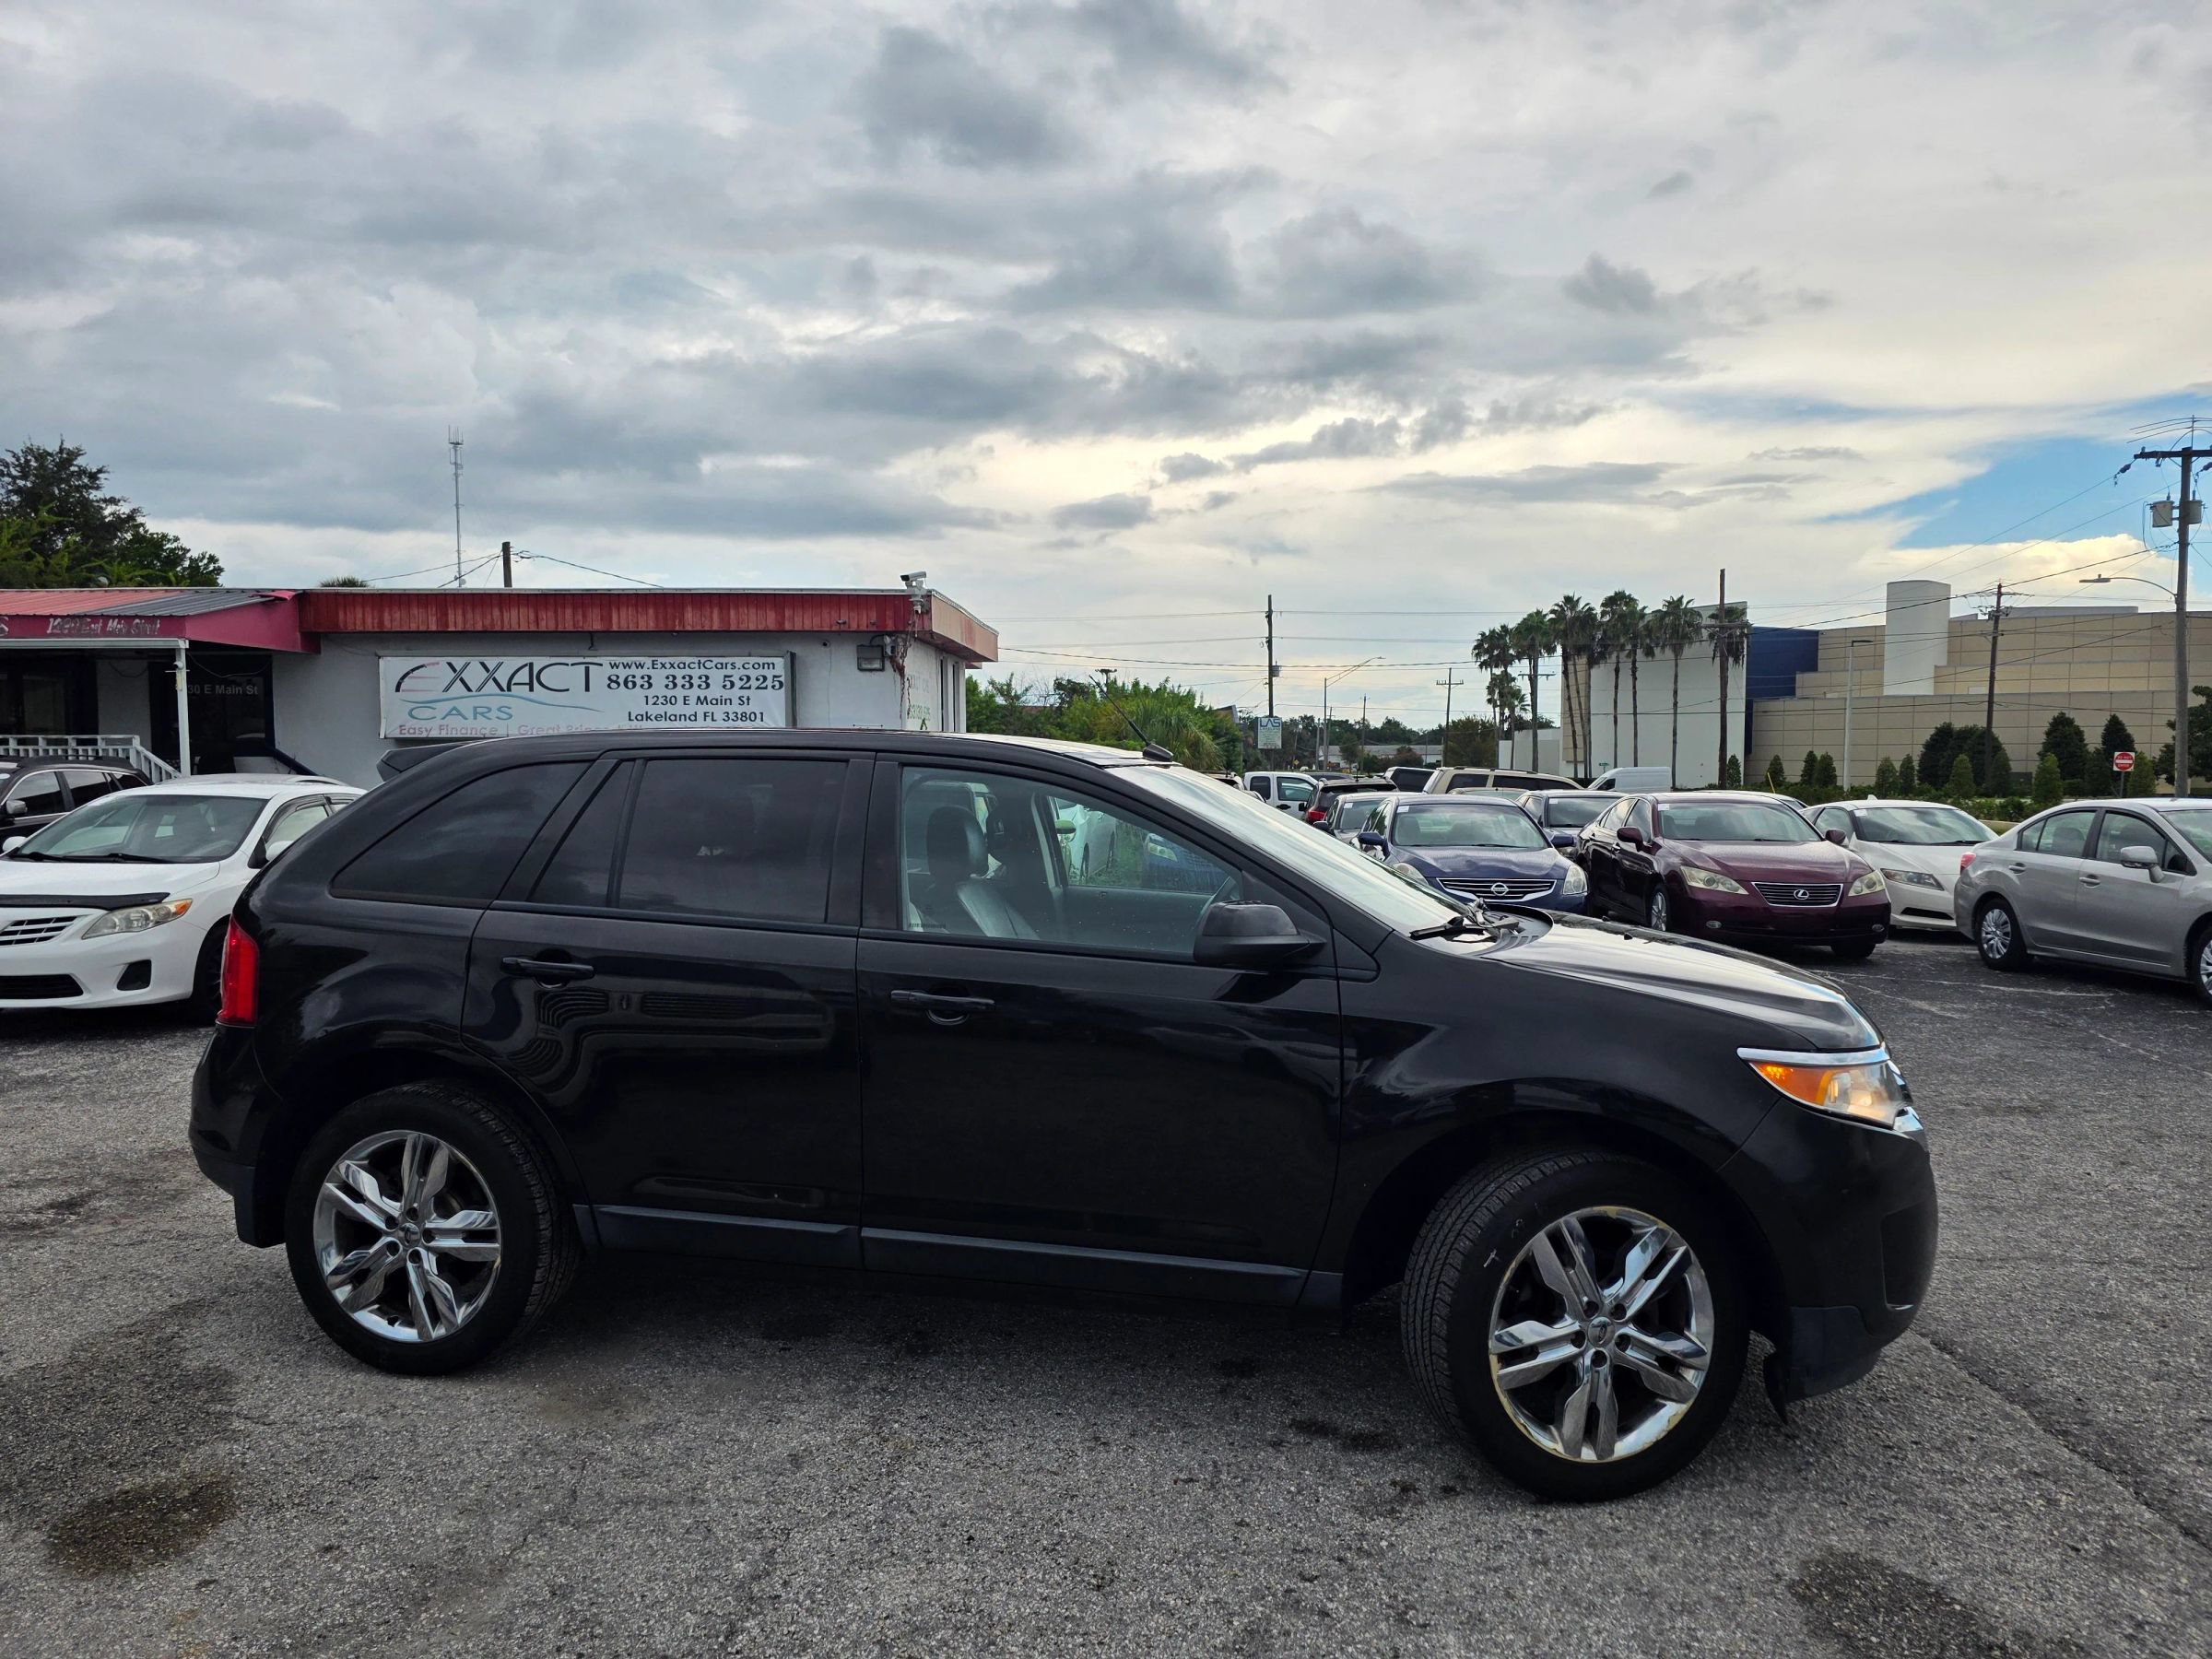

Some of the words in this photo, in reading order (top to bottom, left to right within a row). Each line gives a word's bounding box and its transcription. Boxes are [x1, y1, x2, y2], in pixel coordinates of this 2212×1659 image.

[608, 659, 776, 671] www.ExxactCars.com
[394, 661, 604, 693] EXXACT
[606, 674, 653, 691] 863
[664, 674, 712, 691] 333
[722, 674, 784, 691] 5225
[215, 684, 243, 695] Main
[245, 685, 259, 695] St
[643, 695, 678, 707] 1230
[682, 695, 691, 706] E
[695, 695, 733, 707] Main
[737, 695, 752, 707] St
[407, 705, 513, 721] CARS
[628, 711, 698, 723] Lakeland
[702, 711, 717, 723] FL
[722, 711, 765, 723] 33801
[1260, 718, 1280, 727] LAS
[398, 724, 432, 738] Easy
[438, 724, 499, 737] Finance
